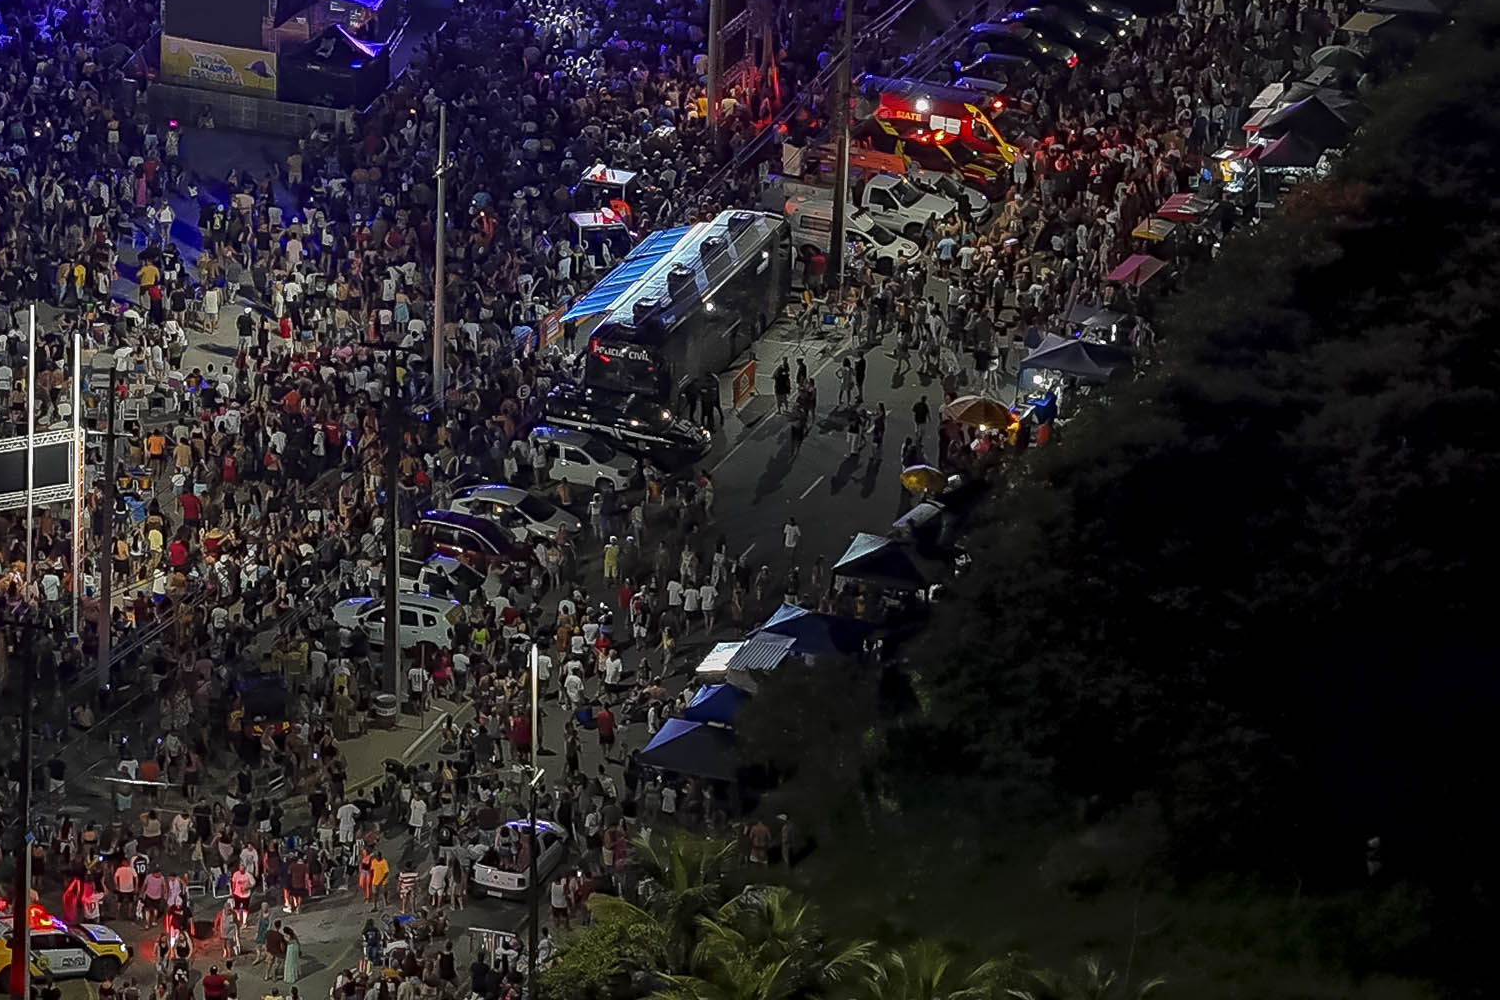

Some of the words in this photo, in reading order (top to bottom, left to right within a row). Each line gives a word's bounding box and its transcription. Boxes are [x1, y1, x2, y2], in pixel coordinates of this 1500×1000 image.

[895, 110, 922, 122] SIATE
[628, 350, 650, 361] CIVIL
[136, 862, 147, 874] 10
